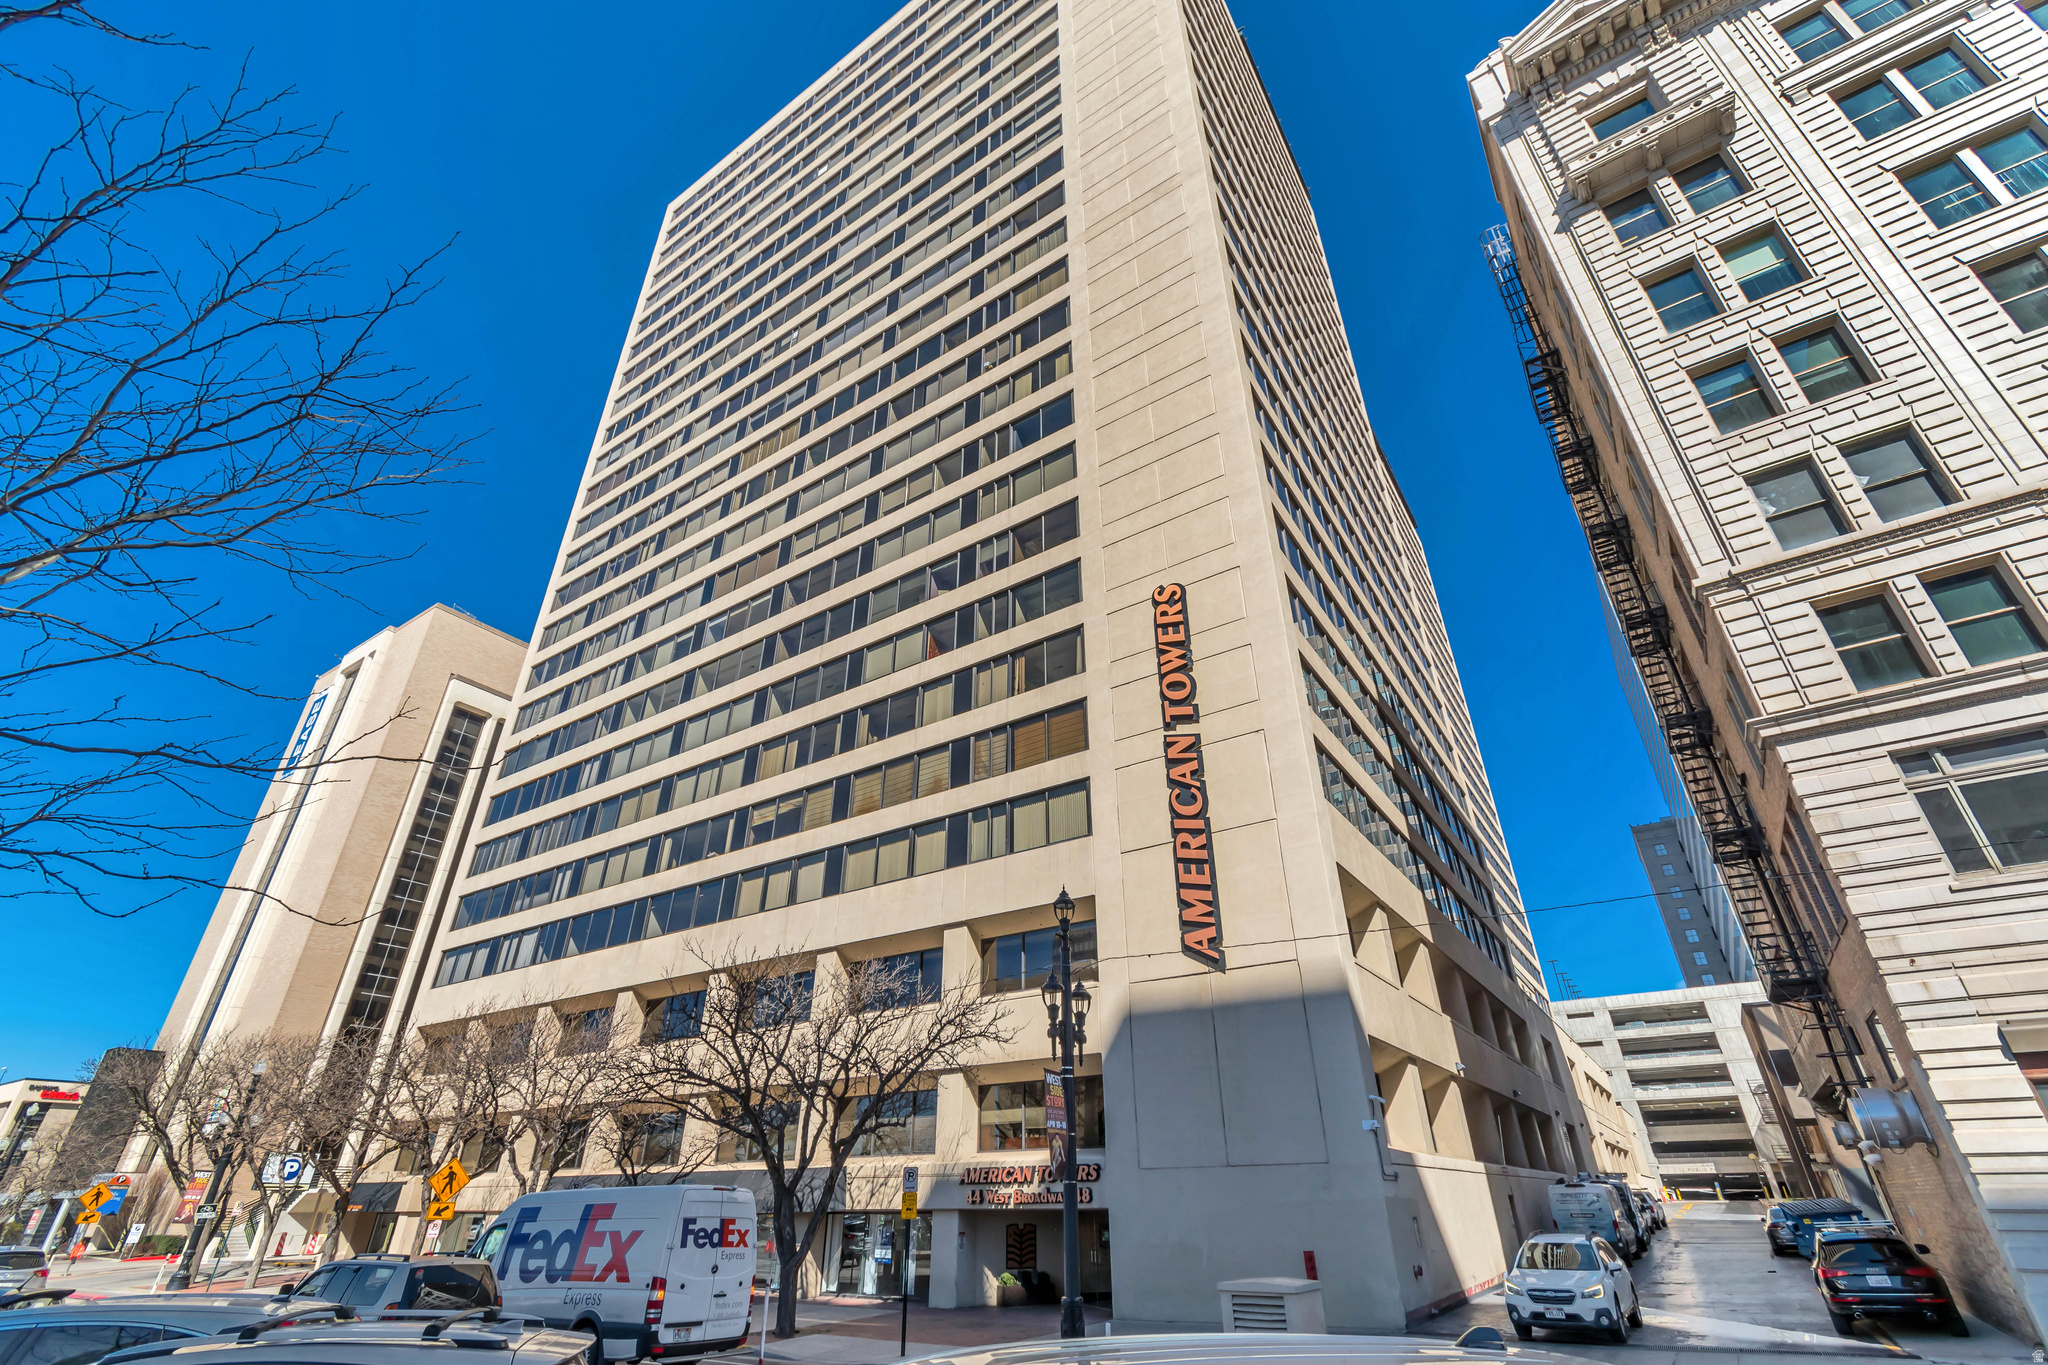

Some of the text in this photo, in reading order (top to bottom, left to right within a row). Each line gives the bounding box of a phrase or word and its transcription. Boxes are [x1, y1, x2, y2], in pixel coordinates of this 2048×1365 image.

[286, 698, 324, 769] LEASE
[1152, 582, 1224, 969] AMERICAN TOWERS
[1045, 1072, 1062, 1087] WEST
[1049, 1085, 1064, 1098] SIDE
[1046, 1095, 1065, 1108] STORY
[284, 1161, 299, 1179] P
[960, 1164, 1099, 1184] AMERICAN TORS
[966, 1190, 981, 1204] 44
[680, 1217, 750, 1249] FedEx
[496, 1202, 645, 1285] FedEx
[721, 1250, 746, 1262] Express
[563, 1287, 603, 1310] Express
[715, 1300, 743, 1310] fedex.com
